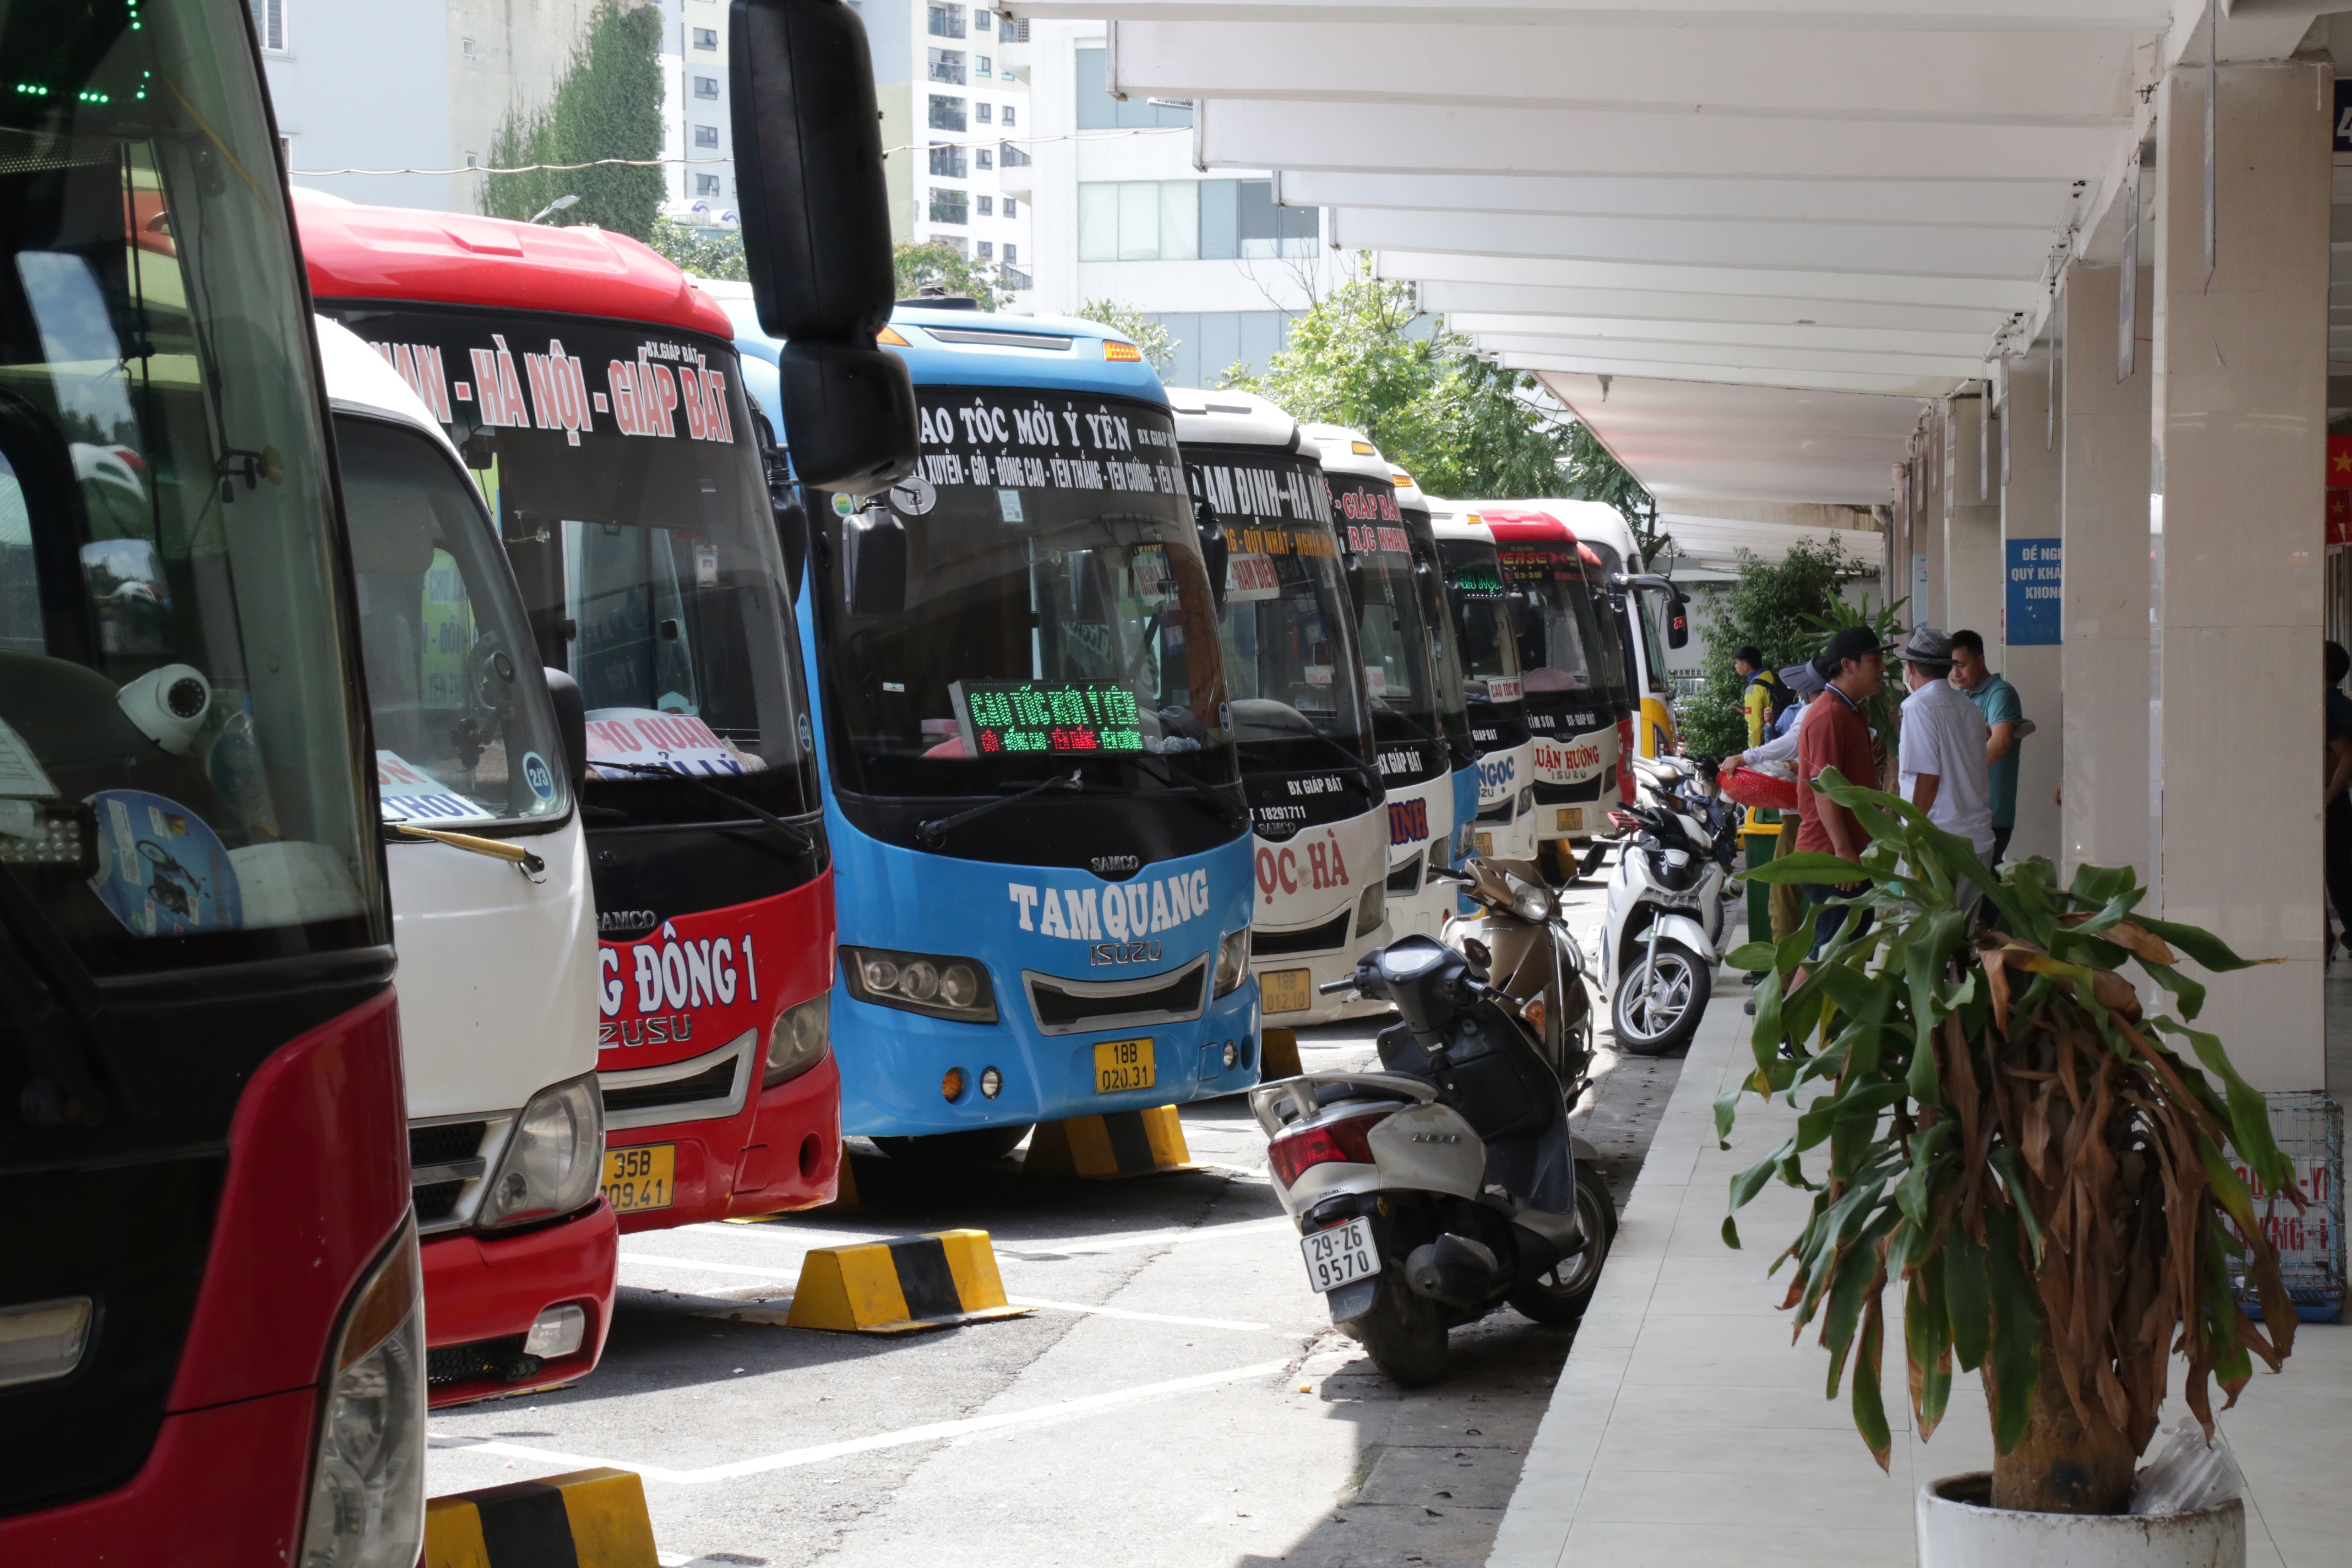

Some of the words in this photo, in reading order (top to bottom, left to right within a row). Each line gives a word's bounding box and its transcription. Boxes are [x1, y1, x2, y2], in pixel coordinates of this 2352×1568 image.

[682, 344, 698, 364] BÁT
[470, 334, 530, 428] HÀ
[524, 339, 593, 446] NỘI
[608, 346, 676, 438] GIÁP
[678, 353, 734, 443] BÁT
[1085, 404, 1131, 451] YÊN
[1137, 428, 1150, 445] BX
[925, 448, 964, 484] XUYÊN
[970, 449, 990, 485] GÔI
[1023, 457, 1046, 488] CAO
[1049, 453, 1072, 488] YÊN
[1106, 456, 1128, 491] YÊN
[1156, 460, 1174, 494] YÊN
[1234, 467, 1282, 524] ĐỊNH
[1286, 464, 1313, 521] HÀ
[1343, 486, 1378, 519] GIÁP
[2011, 565, 2034, 581] QUÝ
[634, 717, 726, 753] QUAN
[1387, 748, 1407, 774] GIÁP
[1406, 747, 1423, 772] BÁT
[1534, 744, 1561, 772] UẬN
[529, 768, 549, 788] 2/3
[1287, 781, 1303, 796] BX
[1303, 776, 1324, 794] GIÁP
[1325, 775, 1343, 792] BÁT
[1551, 770, 1586, 781] ISUZU
[1259, 806, 1306, 821] 18291711
[1258, 822, 1296, 835] SAMCO
[1091, 855, 1139, 871] SAMCO
[1307, 828, 1349, 890] HÀ
[1090, 939, 1162, 966] ISUZU
[632, 919, 737, 1014] ĐÔNG
[741, 933, 759, 1003] 1
[1114, 1043, 1137, 1065] 18B
[1102, 1065, 1147, 1090] 020.31
[614, 1150, 651, 1179] 35B
[1311, 1224, 1363, 1262] 29-Z6
[1318, 1250, 1370, 1286] 9570
